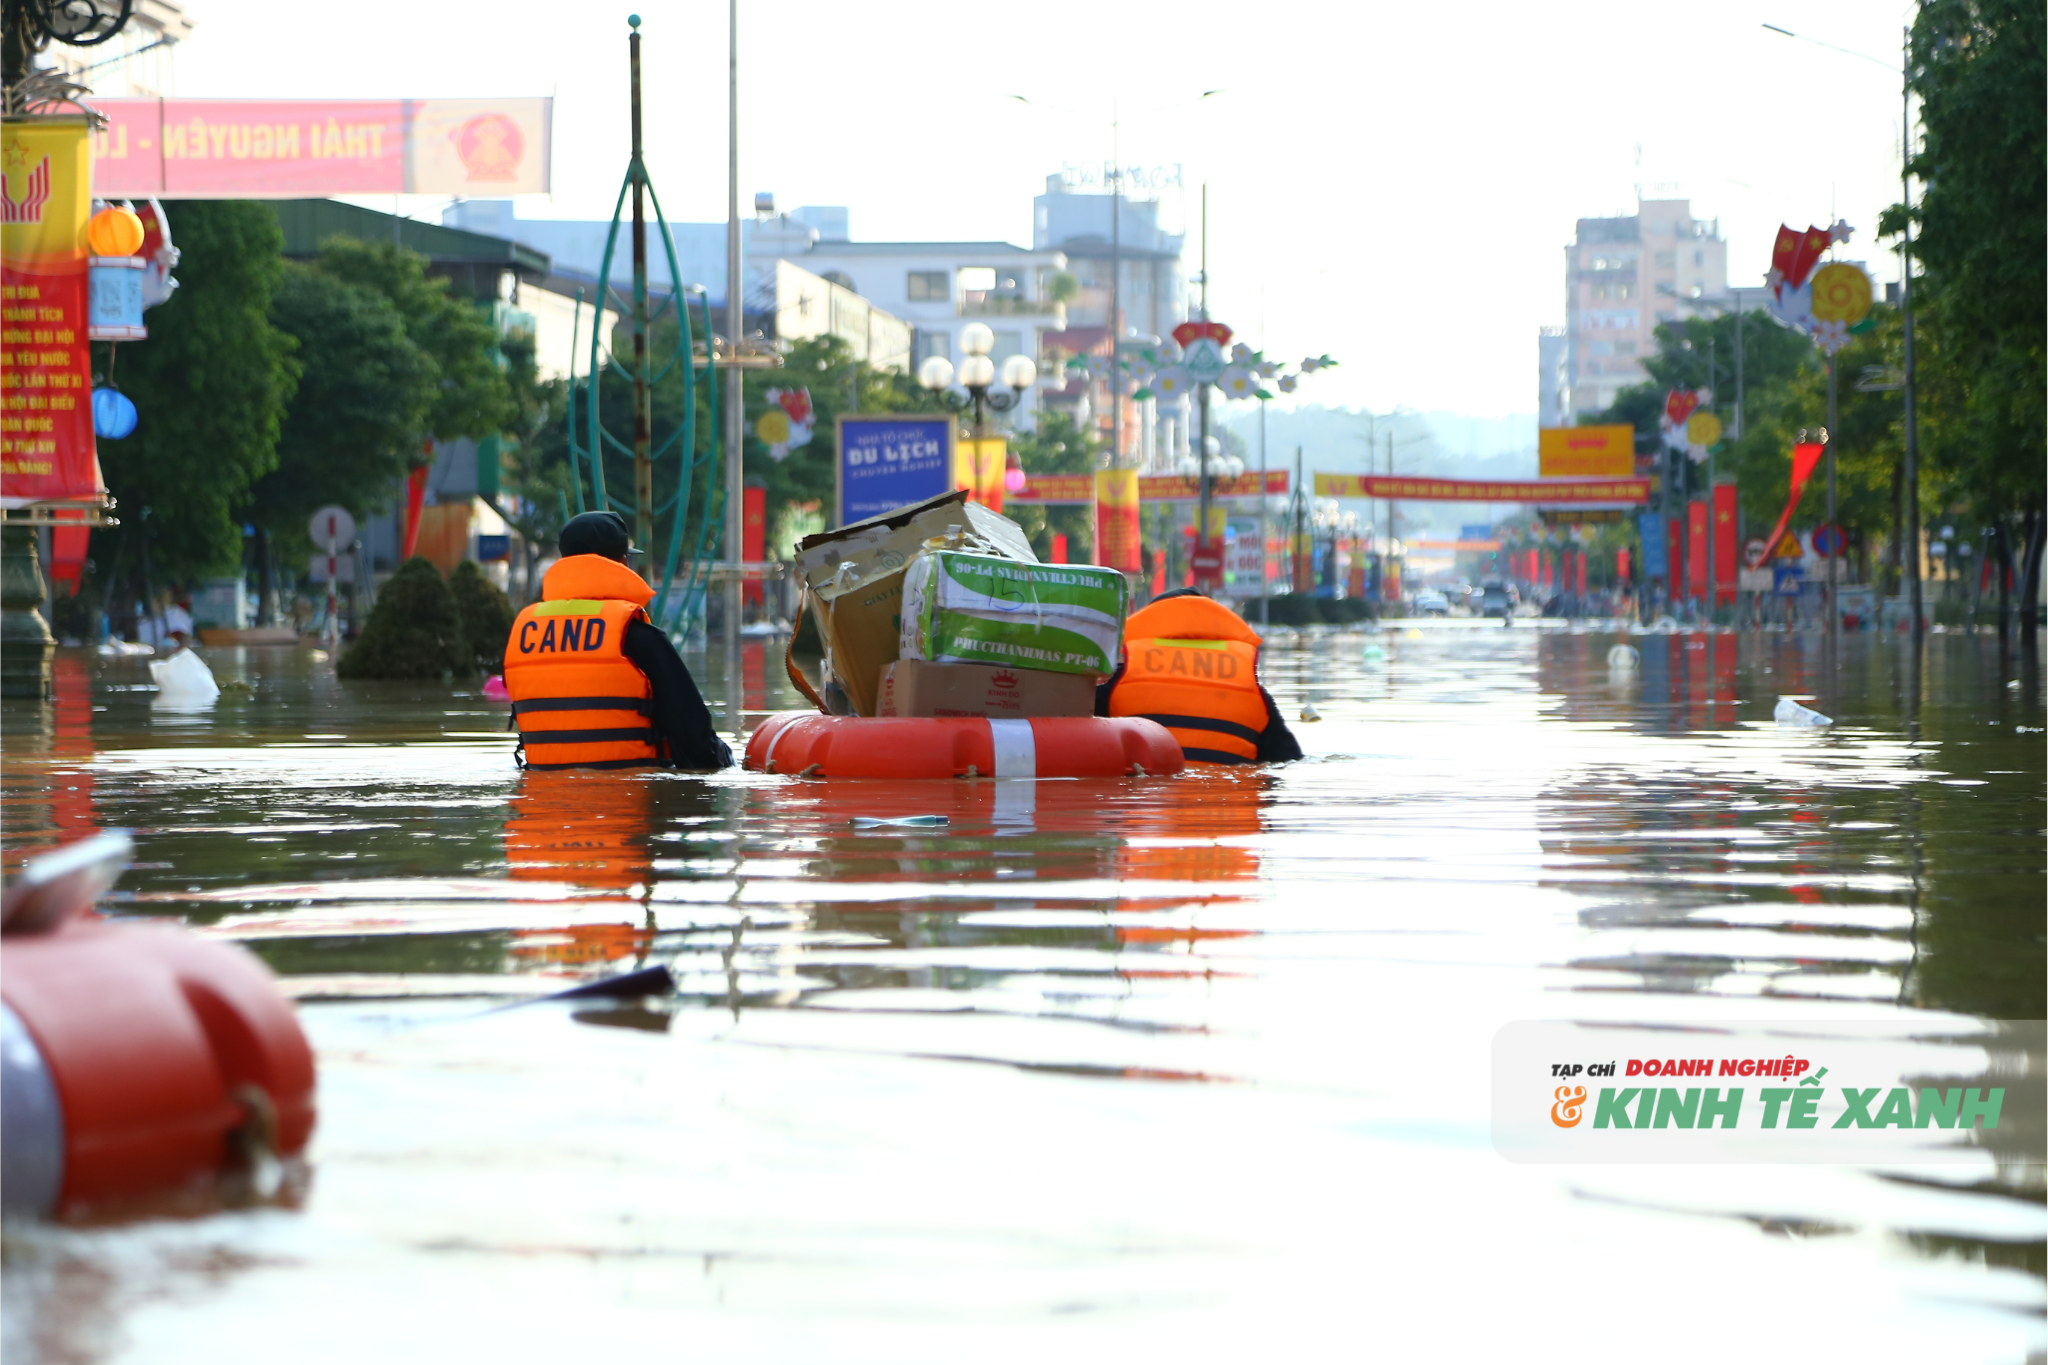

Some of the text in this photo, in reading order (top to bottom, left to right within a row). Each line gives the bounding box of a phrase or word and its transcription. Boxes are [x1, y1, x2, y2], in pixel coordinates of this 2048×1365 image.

[848, 439, 939, 466] DU LỊCH
[956, 562, 1103, 589] PHUCTHANHMAS PT-06
[989, 577, 1025, 611] 15
[520, 618, 606, 654] CAND
[953, 636, 1100, 668] PHUCTHANHMAS PT-06
[1144, 648, 1238, 679] CAND
